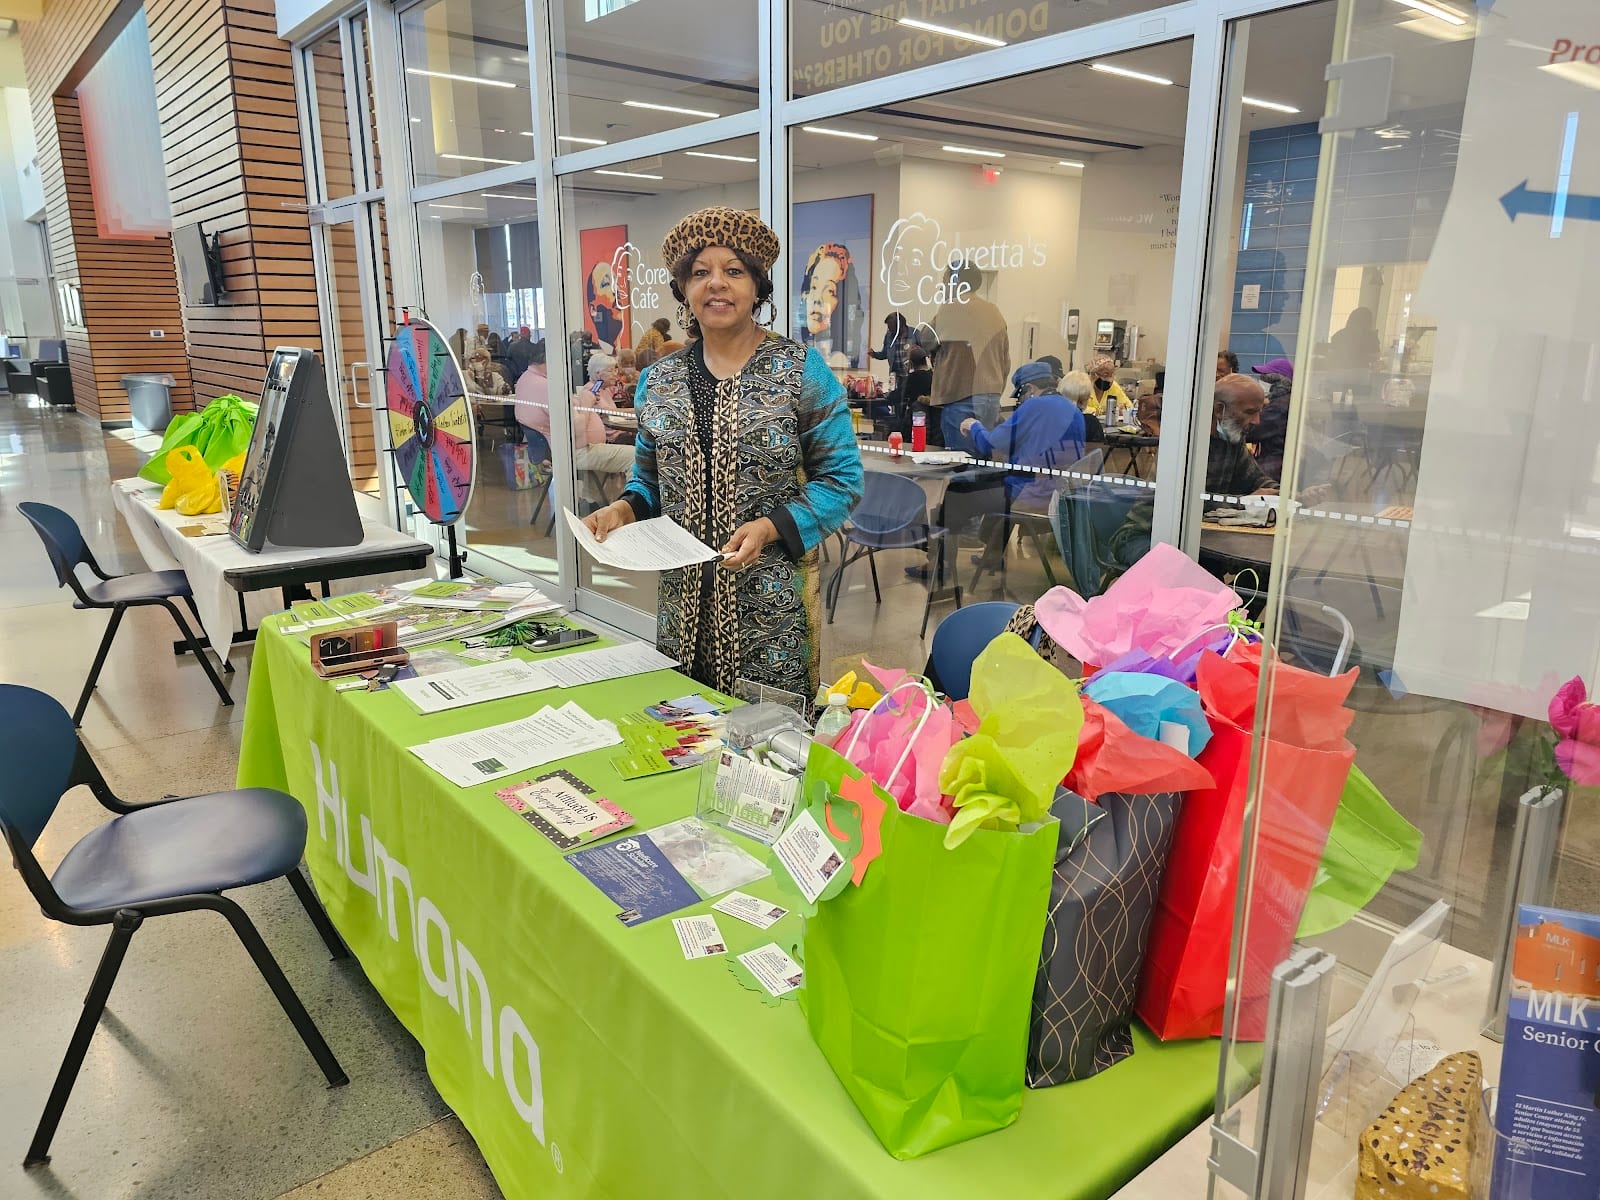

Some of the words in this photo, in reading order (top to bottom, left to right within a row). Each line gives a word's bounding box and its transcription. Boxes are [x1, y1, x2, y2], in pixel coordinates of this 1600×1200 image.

[930, 234, 1048, 271] Coretta's
[631, 287, 659, 309] Cafe
[917, 274, 971, 305] Cafe
[553, 790, 590, 815] Attitude
[310, 739, 545, 1148] Humana
[1546, 933, 1570, 946] MLK
[1527, 989, 1591, 1029] MLK
[1522, 1025, 1590, 1051] Senior
[1514, 1109, 1534, 1117] Senior
[1534, 1113, 1555, 1121] Center
[1514, 1116, 1536, 1124] adultos
[1536, 1120, 1563, 1130] (mayores
[1544, 1108, 1563, 1117] Luther
[1564, 1112, 1579, 1121] King
[1518, 1129, 1543, 1140] servicios
[1530, 1126, 1541, 1134] que
[1542, 1127, 1563, 1136] buscan
